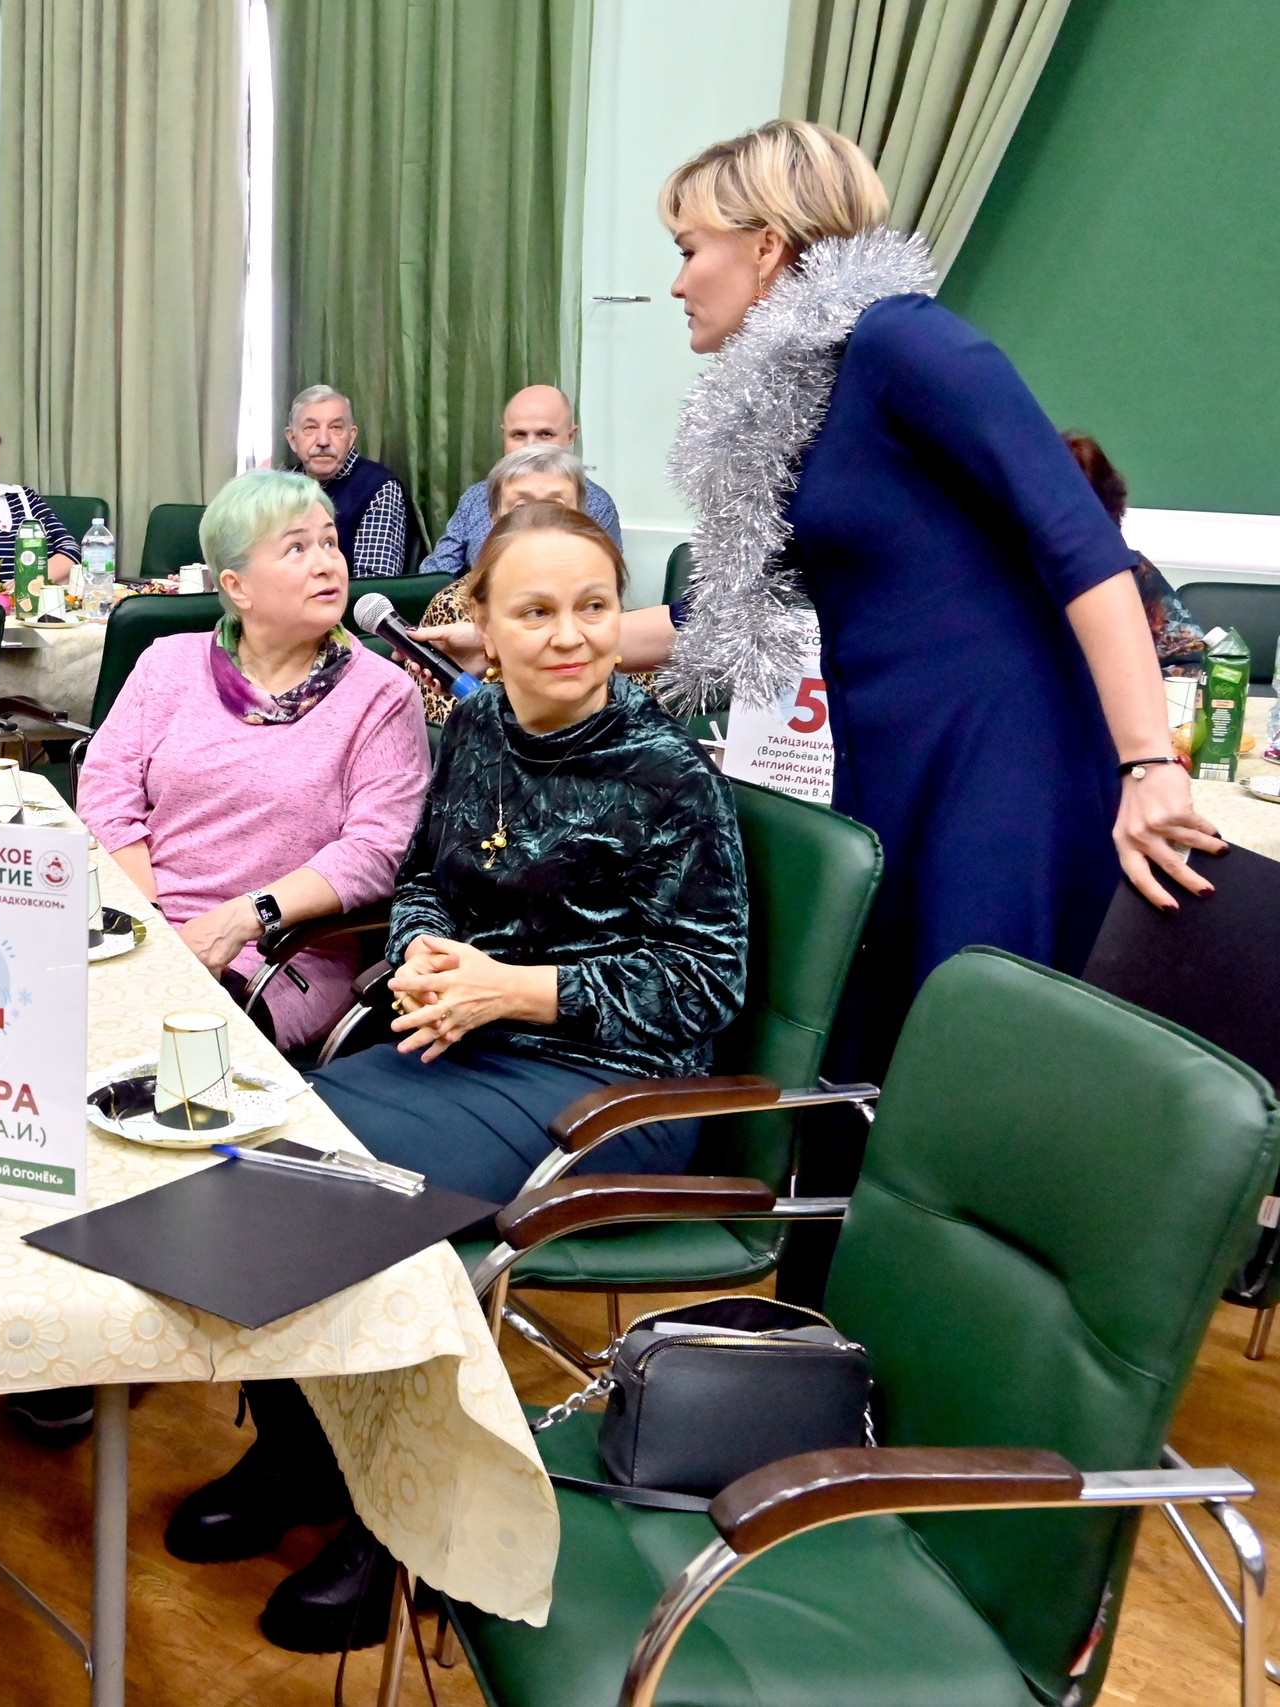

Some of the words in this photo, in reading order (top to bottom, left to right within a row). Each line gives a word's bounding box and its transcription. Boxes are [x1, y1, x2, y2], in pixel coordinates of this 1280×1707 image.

[787, 677, 827, 733] 5
[757, 746, 819, 761] (Воробьёва
[751, 760, 822, 775] АНГЛИЙСКИЙ
[770, 773, 830, 787] «ОН-ЛАЙН»
[12, 1168, 64, 1185] ОГОНЁК»
